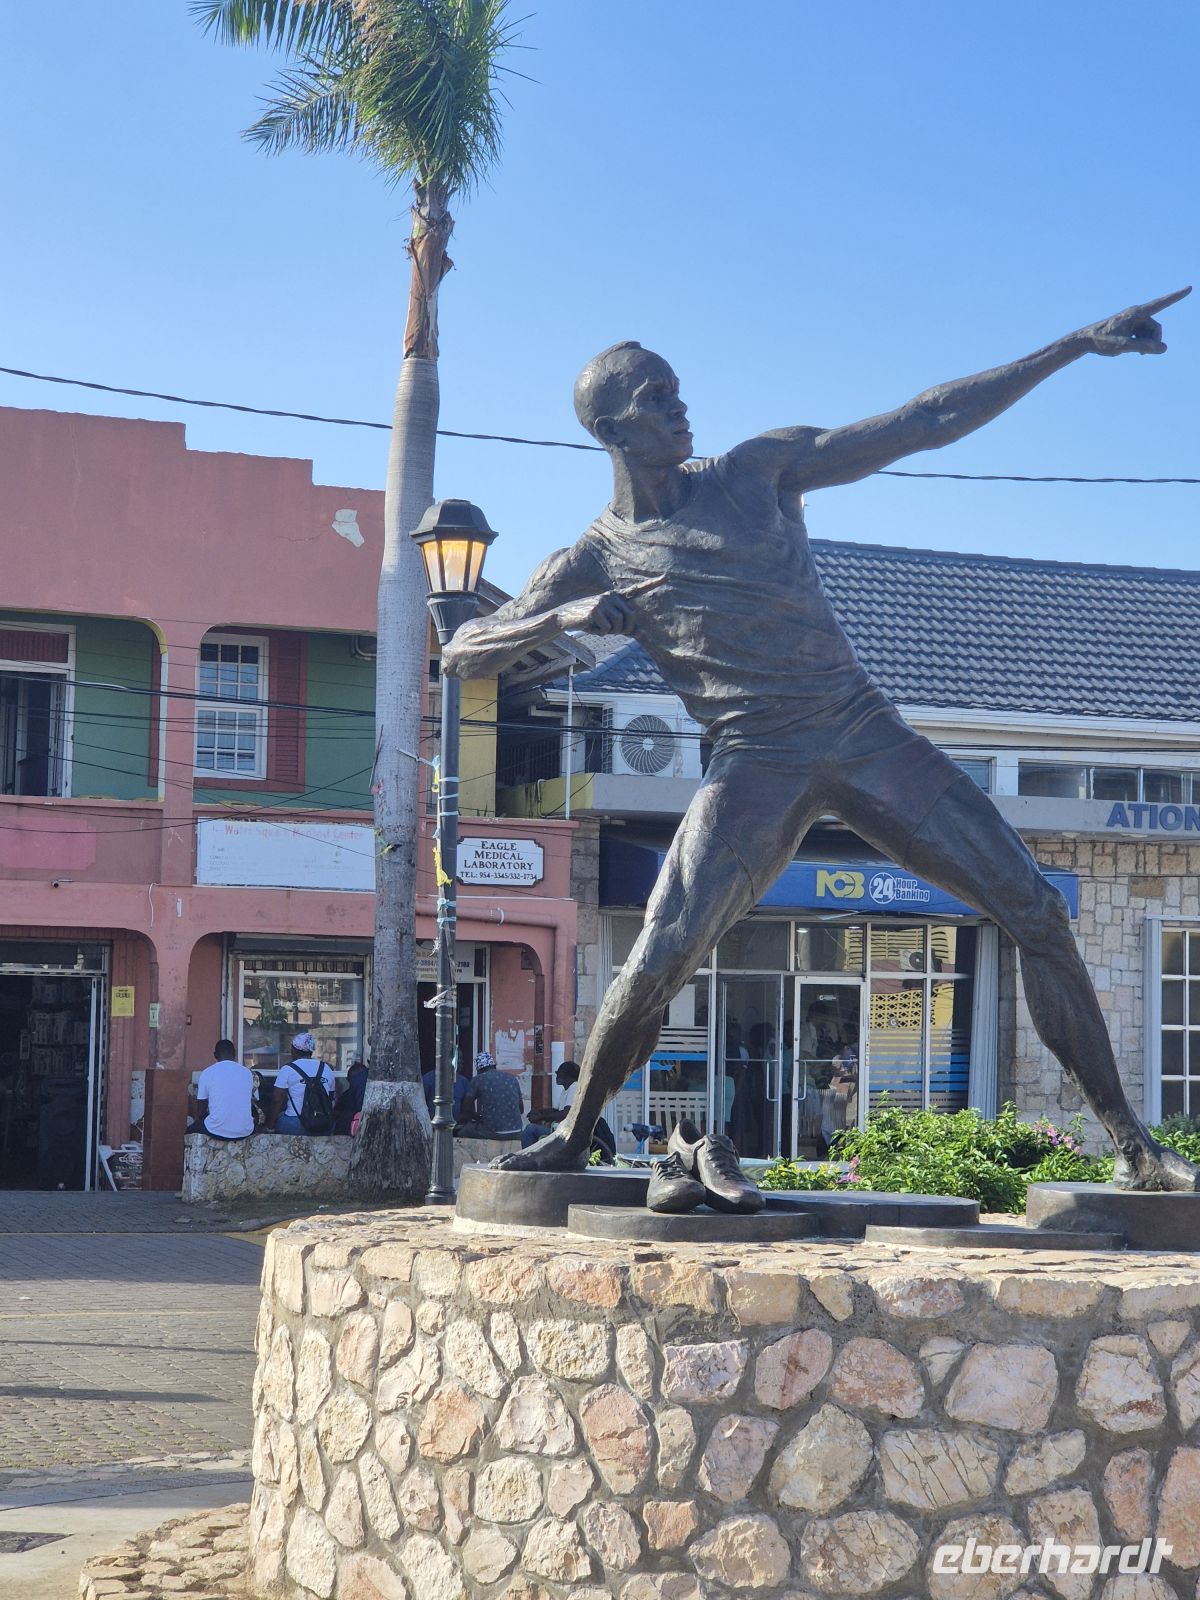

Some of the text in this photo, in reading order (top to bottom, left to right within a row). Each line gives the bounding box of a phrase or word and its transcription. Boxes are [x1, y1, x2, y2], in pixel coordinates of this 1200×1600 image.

[481, 840, 517, 851] EAGLE
[474, 850, 524, 861] MEDICAL
[463, 859, 534, 871] LABORATORY
[460, 871, 478, 879] TEL:
[816, 869, 865, 898] NCB
[873, 877, 918, 899] 24 Hour
[894, 888, 930, 902] Banking
